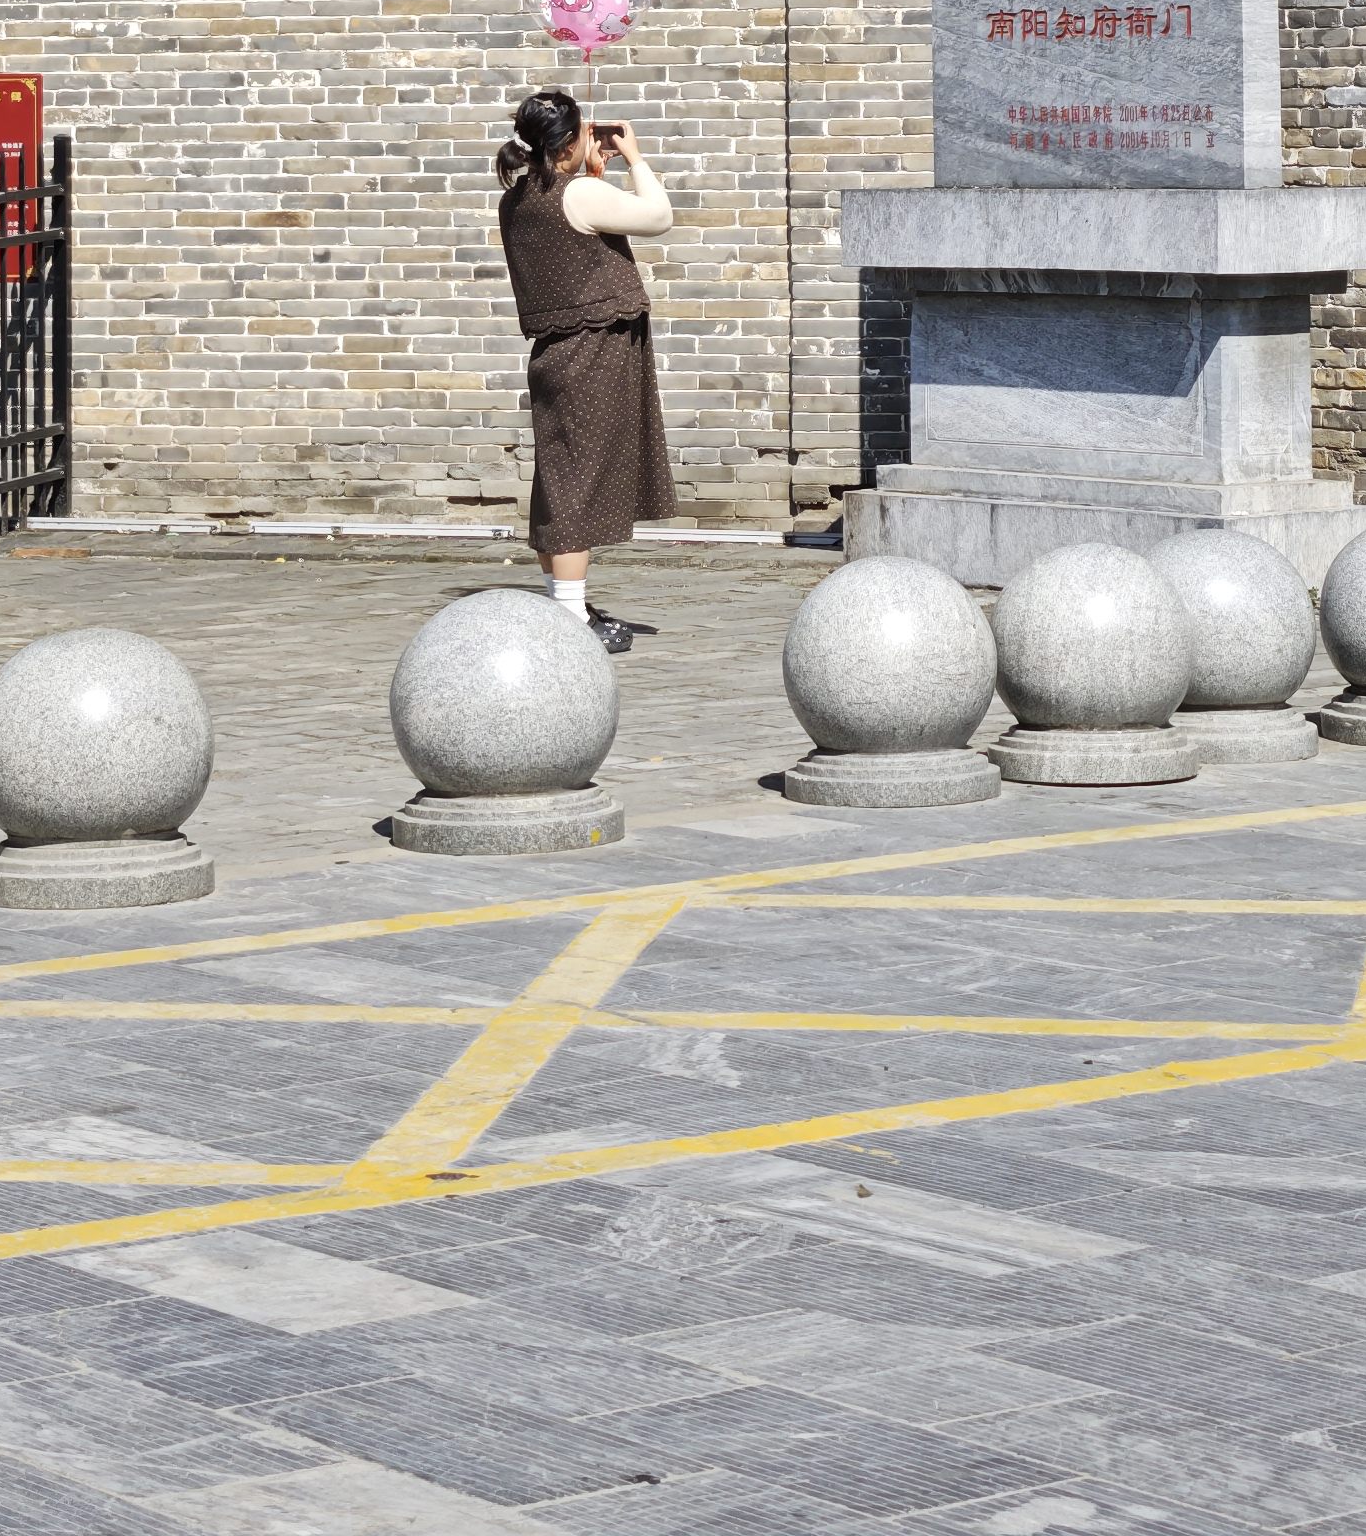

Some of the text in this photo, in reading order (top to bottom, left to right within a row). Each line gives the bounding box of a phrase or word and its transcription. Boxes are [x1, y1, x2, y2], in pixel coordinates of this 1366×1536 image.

[986, 3, 1193, 42] 南阳知府衙门
[1008, 105, 1114, 124] 中华人民共和国国务院
[1009, 131, 1115, 151] 河南省人民政府
